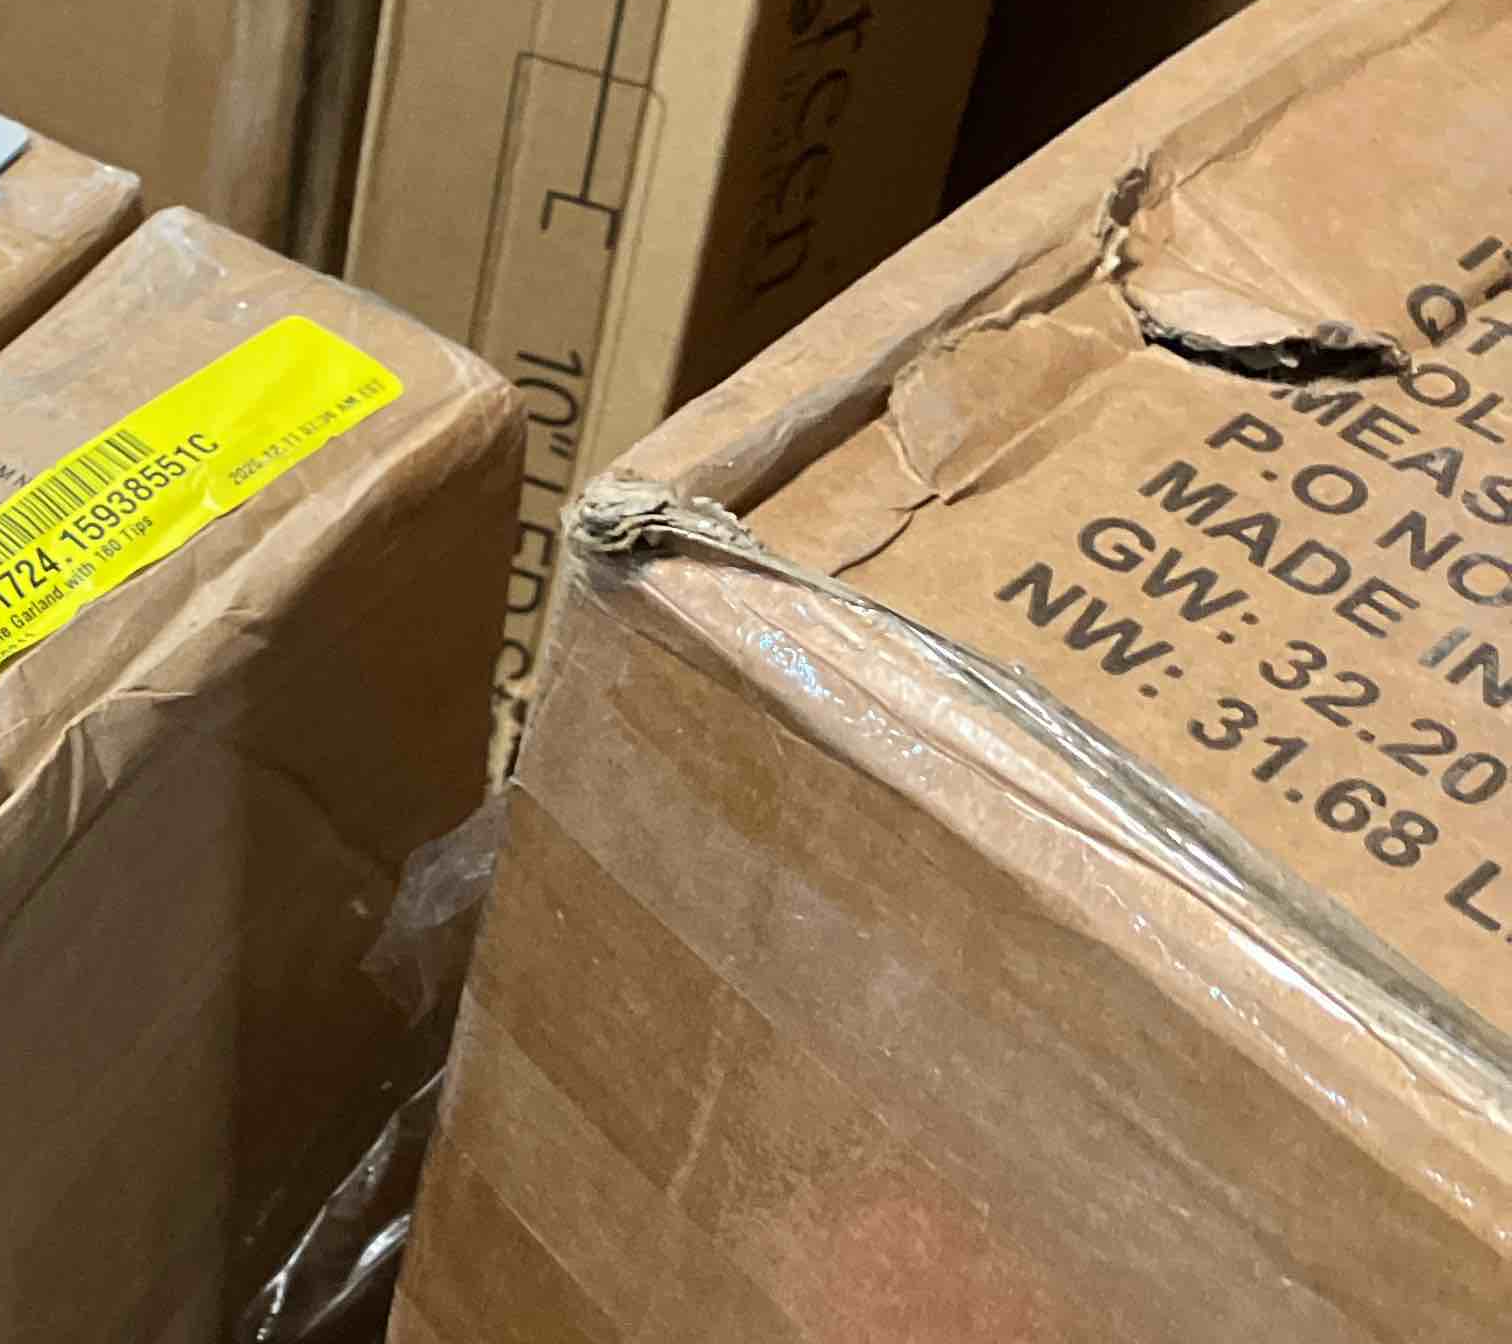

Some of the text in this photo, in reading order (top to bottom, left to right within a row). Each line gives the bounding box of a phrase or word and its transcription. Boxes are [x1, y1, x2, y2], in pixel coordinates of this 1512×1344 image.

[10, 585, 65, 630] Garland
[67, 560, 98, 598] with
[119, 514, 155, 549] Tips
[1077, 516, 1507, 805] GW: 32.20
[1138, 460, 1421, 639] MADE
[995, 562, 1183, 698] NW:
[1189, 697, 1440, 868] 31.68
